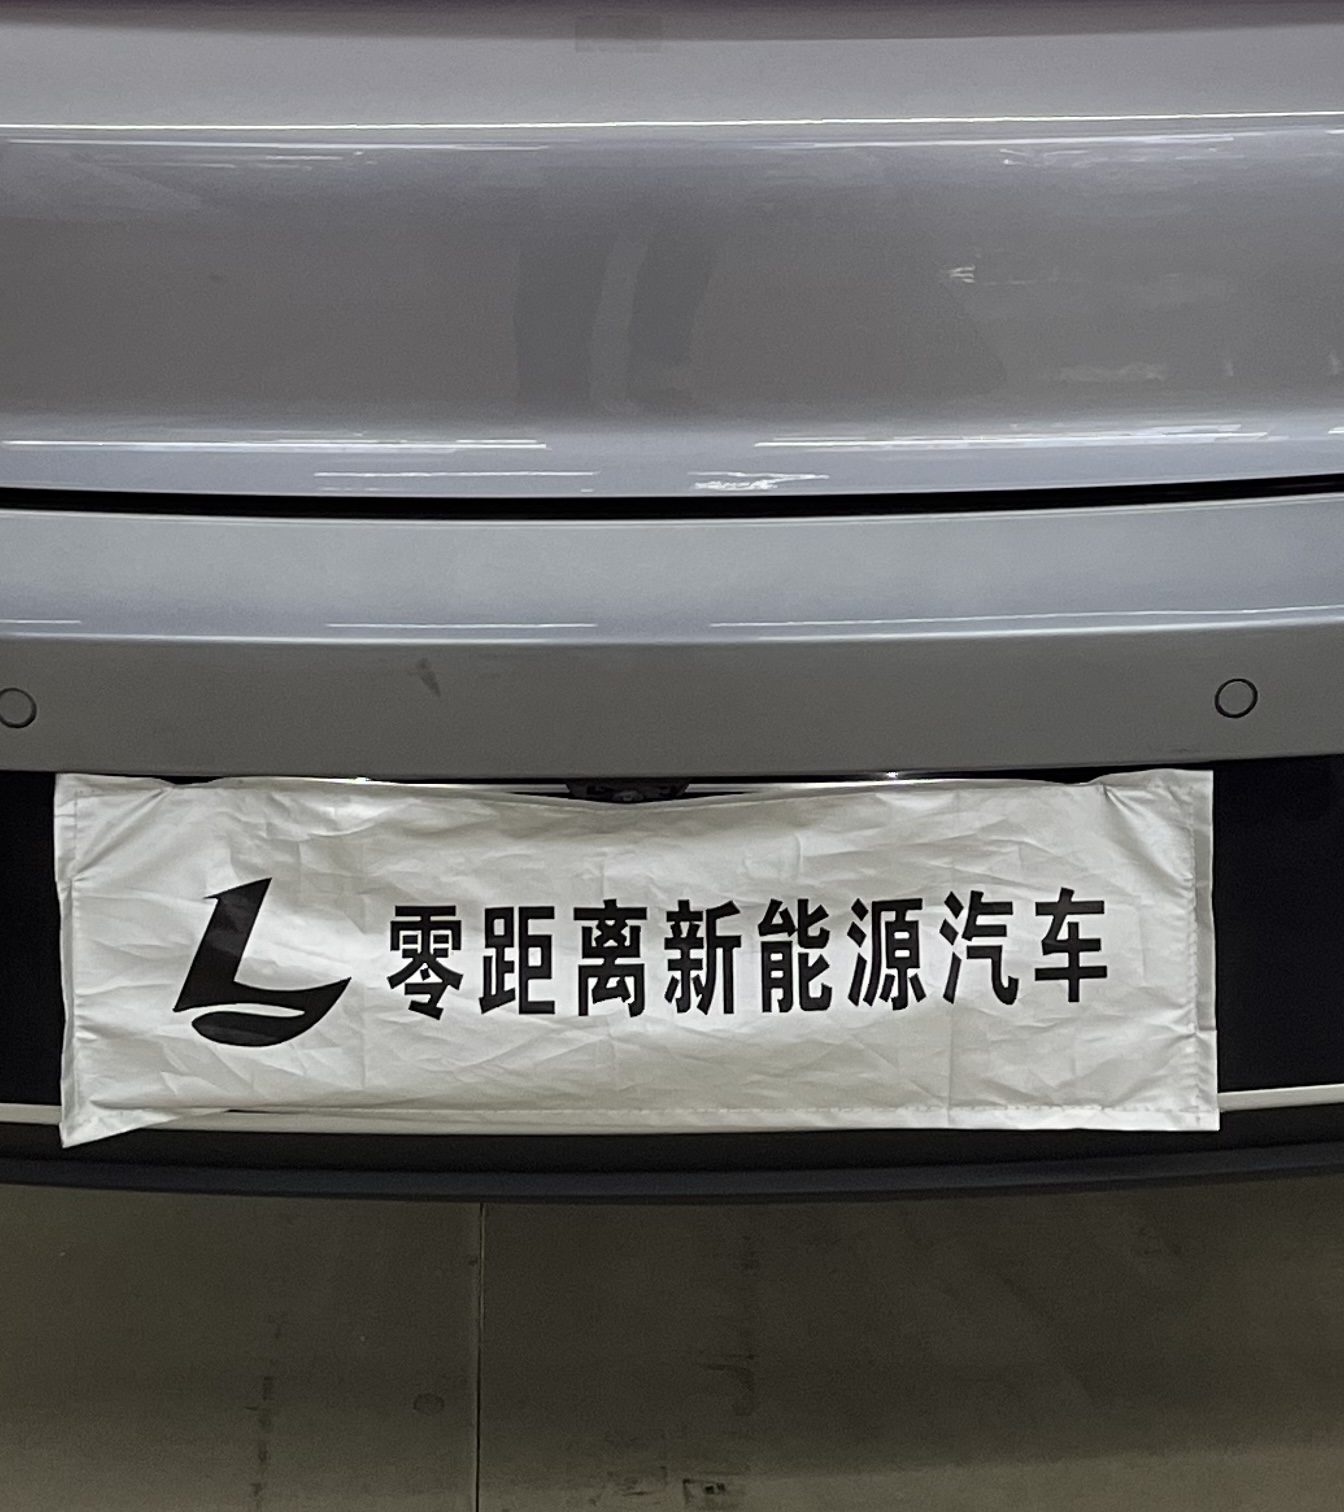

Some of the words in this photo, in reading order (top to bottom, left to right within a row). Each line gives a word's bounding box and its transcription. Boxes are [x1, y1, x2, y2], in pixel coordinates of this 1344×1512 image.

[385, 885, 1110, 1022] 零距离新能源汽车
